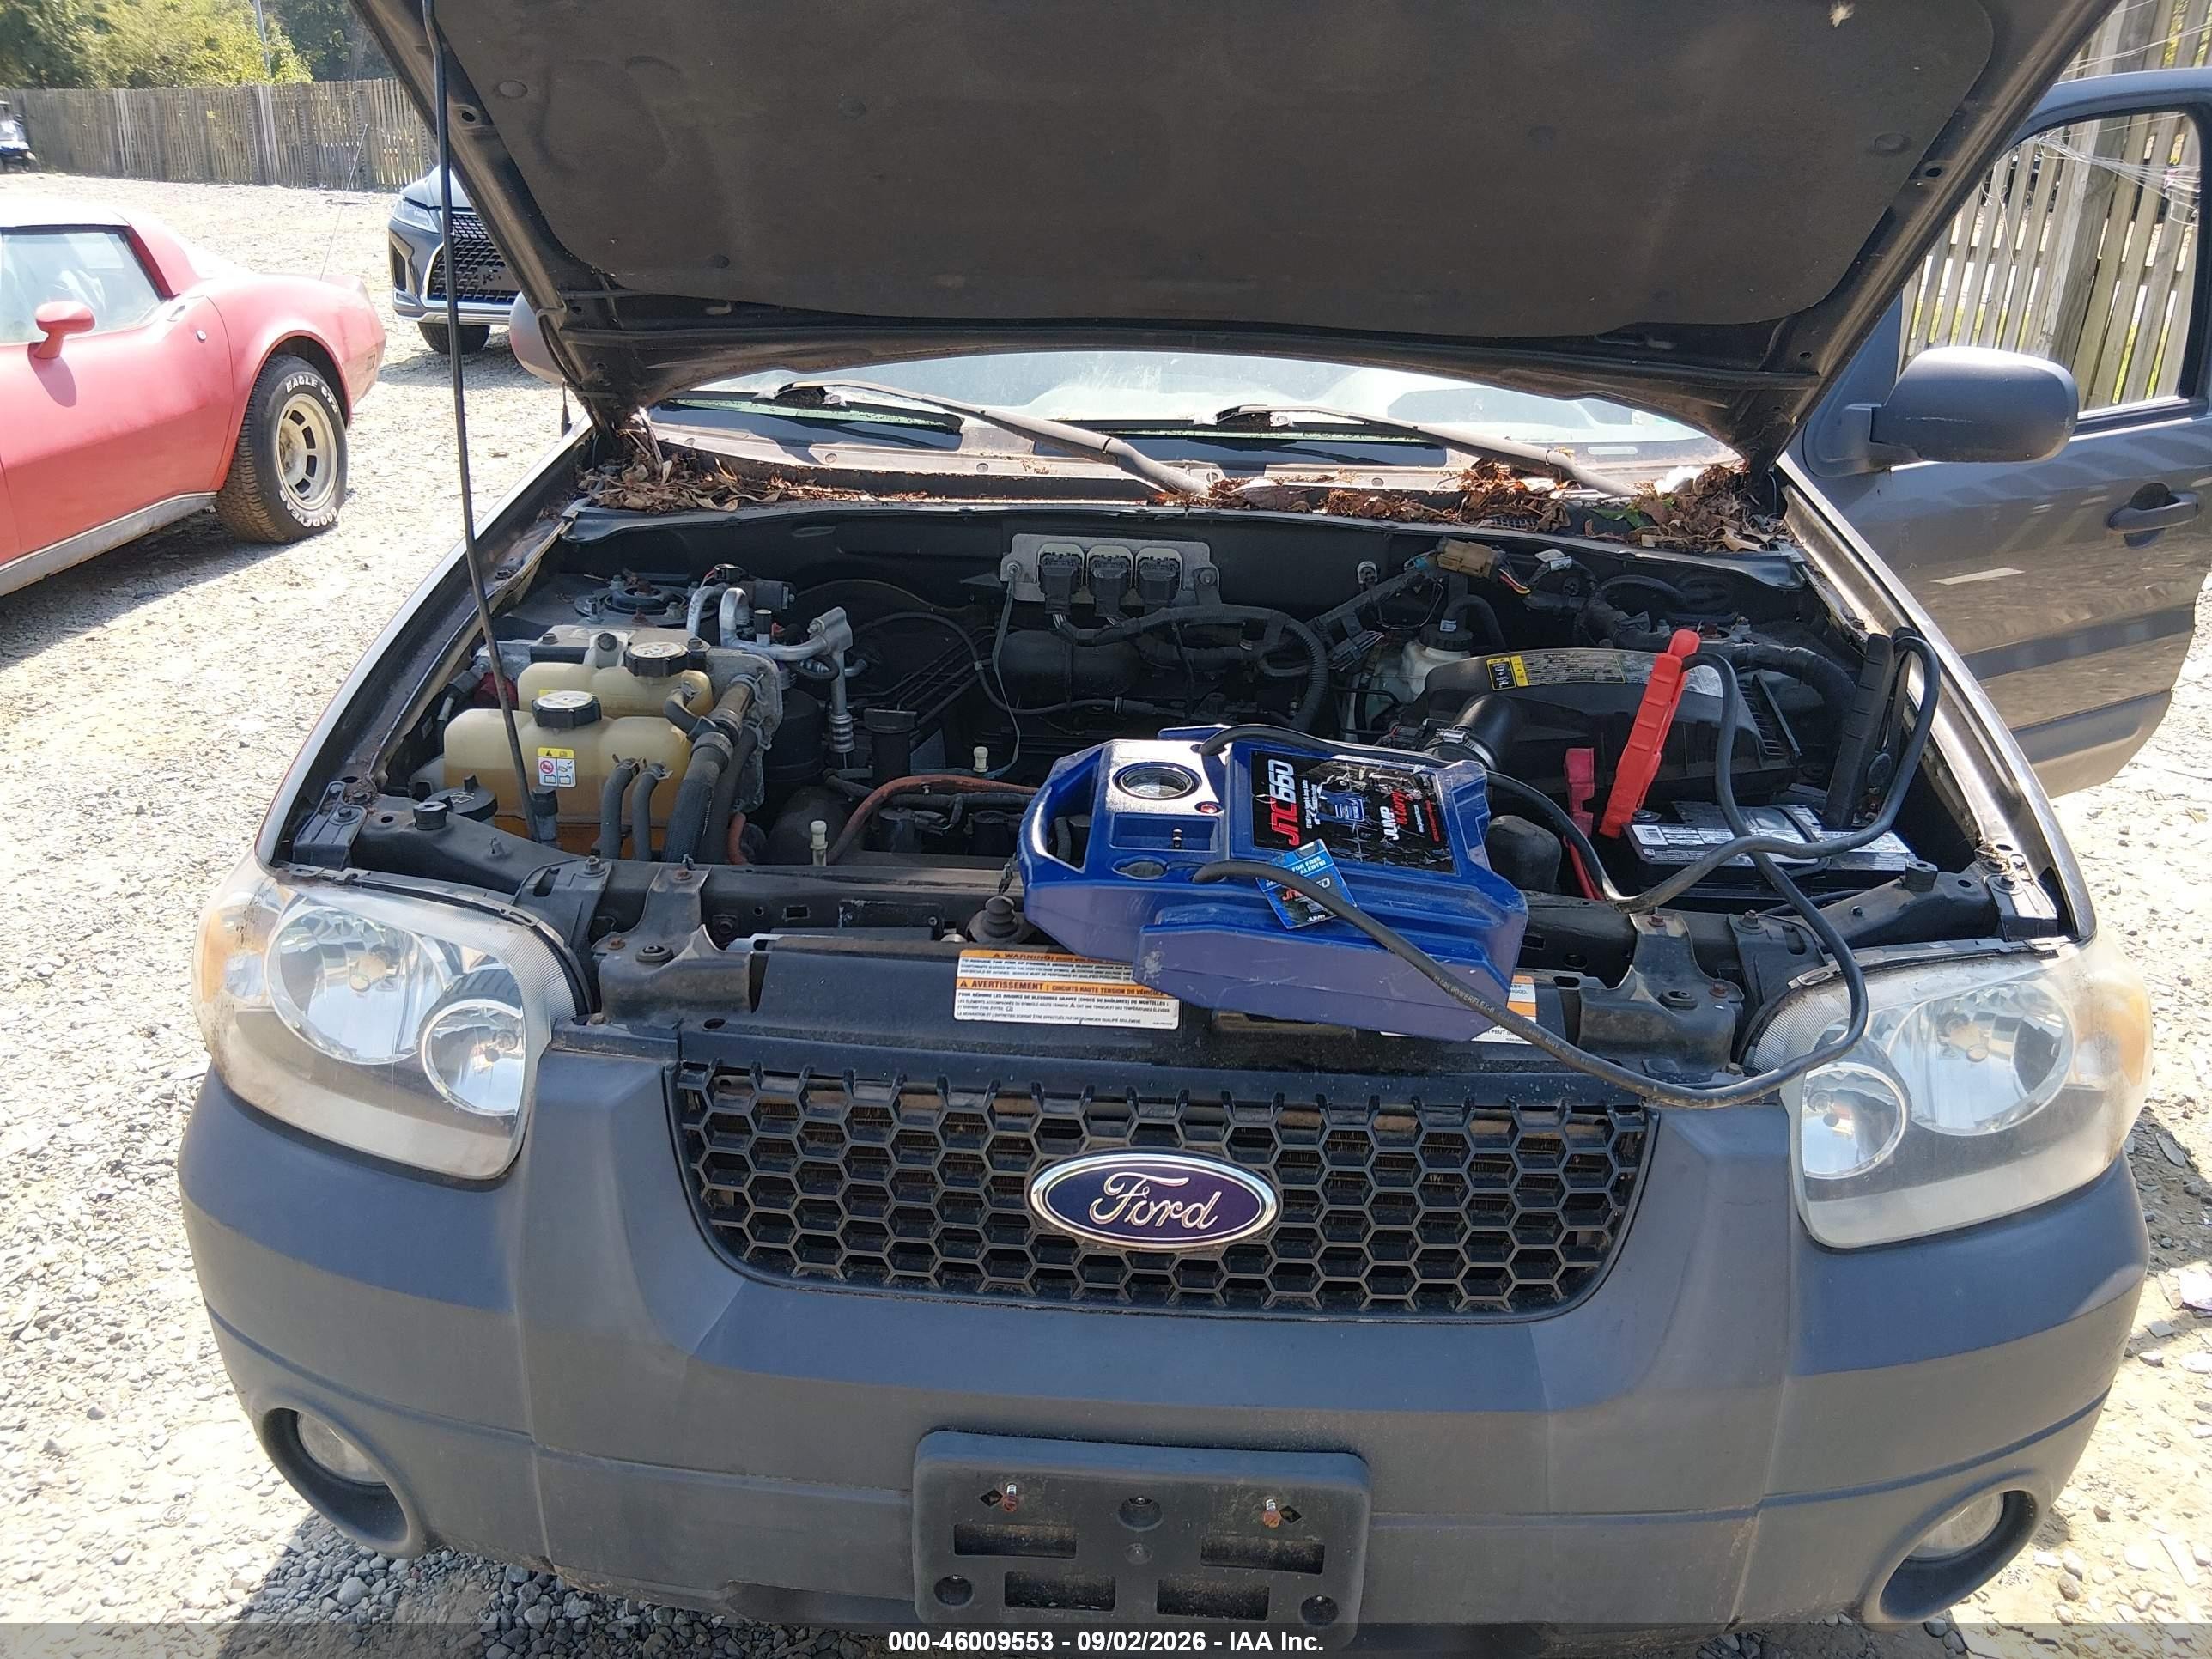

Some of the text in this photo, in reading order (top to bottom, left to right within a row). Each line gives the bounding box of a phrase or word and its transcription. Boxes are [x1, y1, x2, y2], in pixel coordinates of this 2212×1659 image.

[286, 375, 319, 393] EAGLE
[279, 489, 337, 528] GOODYEAR
[1268, 759, 1301, 846] JNC660
[1379, 805, 1400, 841] JUMP
[1291, 856, 1322, 872] FOR FREE
[971, 980, 1044, 990] AVERTISSEMENT
[1089, 1170, 1223, 1230] Ford
